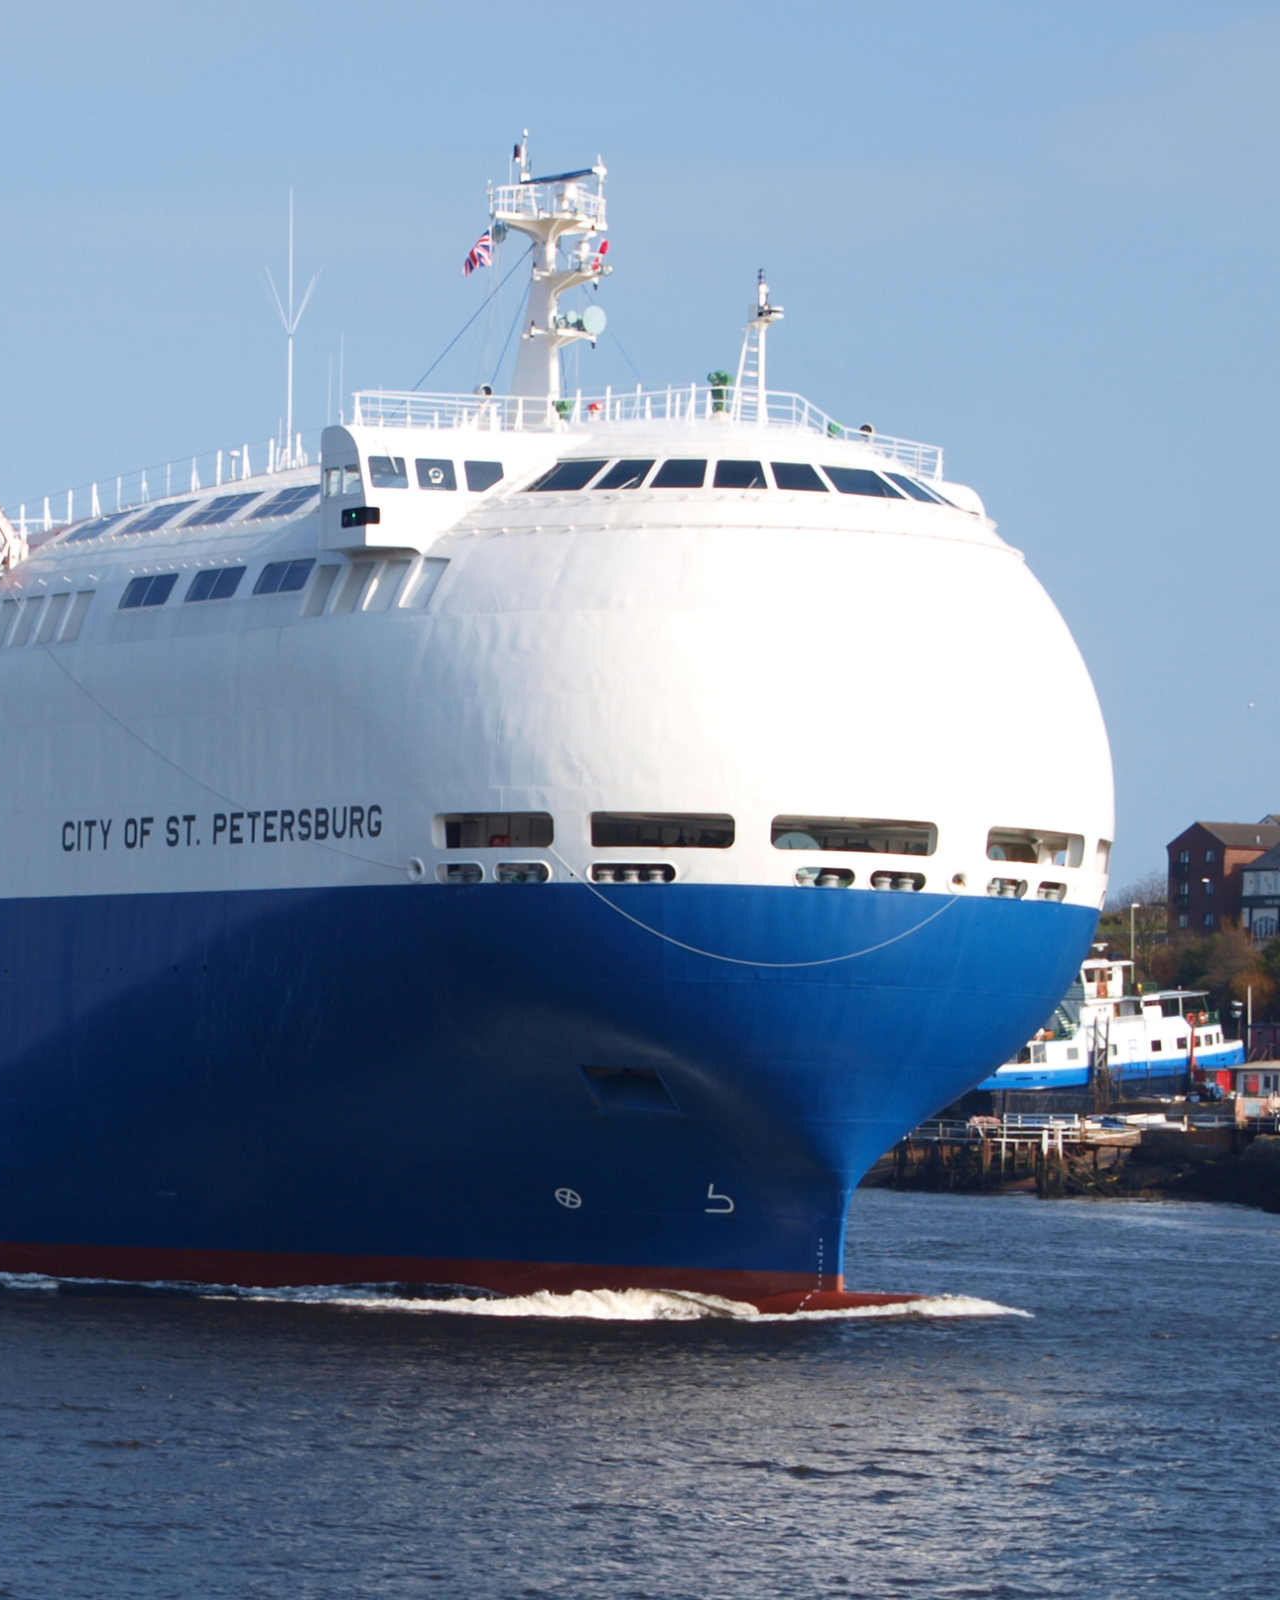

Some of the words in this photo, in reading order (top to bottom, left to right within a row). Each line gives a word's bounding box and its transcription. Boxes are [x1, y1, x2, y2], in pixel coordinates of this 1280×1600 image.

[62, 819, 112, 852] CITY
[124, 816, 154, 849] OF
[166, 814, 201, 847] ST.
[212, 804, 383, 845] PETERSBURG
